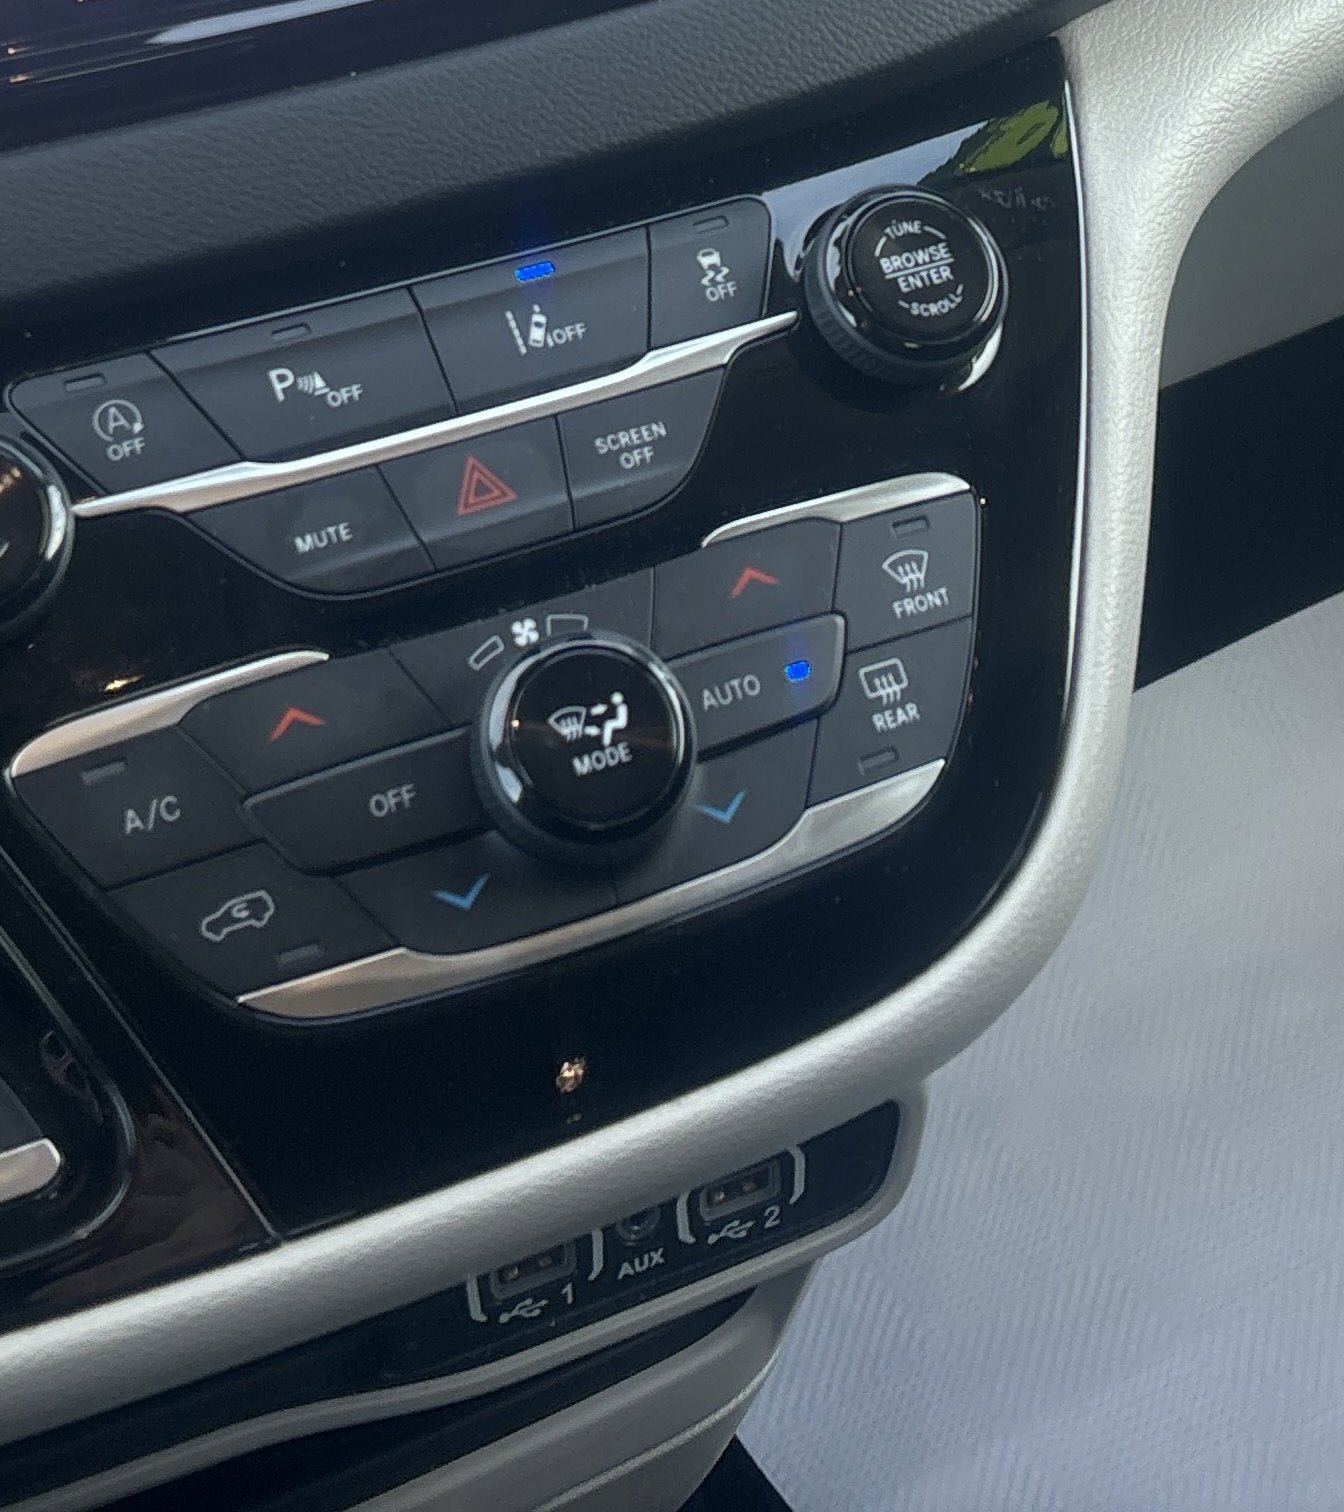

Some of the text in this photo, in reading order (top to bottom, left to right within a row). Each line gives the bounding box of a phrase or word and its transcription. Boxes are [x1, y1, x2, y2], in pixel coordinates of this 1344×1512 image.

[879, 241, 952, 274] BROWSE
[705, 282, 738, 302] OFF
[897, 265, 954, 293] ENTER
[910, 293, 963, 317] SCROLL
[554, 323, 587, 344] OFF
[327, 384, 364, 408] OFF
[107, 438, 146, 460] OFF
[595, 422, 668, 455] SCREEN
[620, 447, 655, 470] OFF
[295, 522, 354, 553] MUTE
[893, 587, 949, 619] FRONT
[701, 675, 761, 711] AUTO
[873, 703, 920, 732] REAR
[572, 742, 633, 778] MODE
[123, 793, 182, 836] A/C
[368, 785, 416, 819] OFF
[764, 1205, 782, 1228] 2
[618, 1247, 666, 1280] AUX
[562, 1283, 574, 1305] 1
